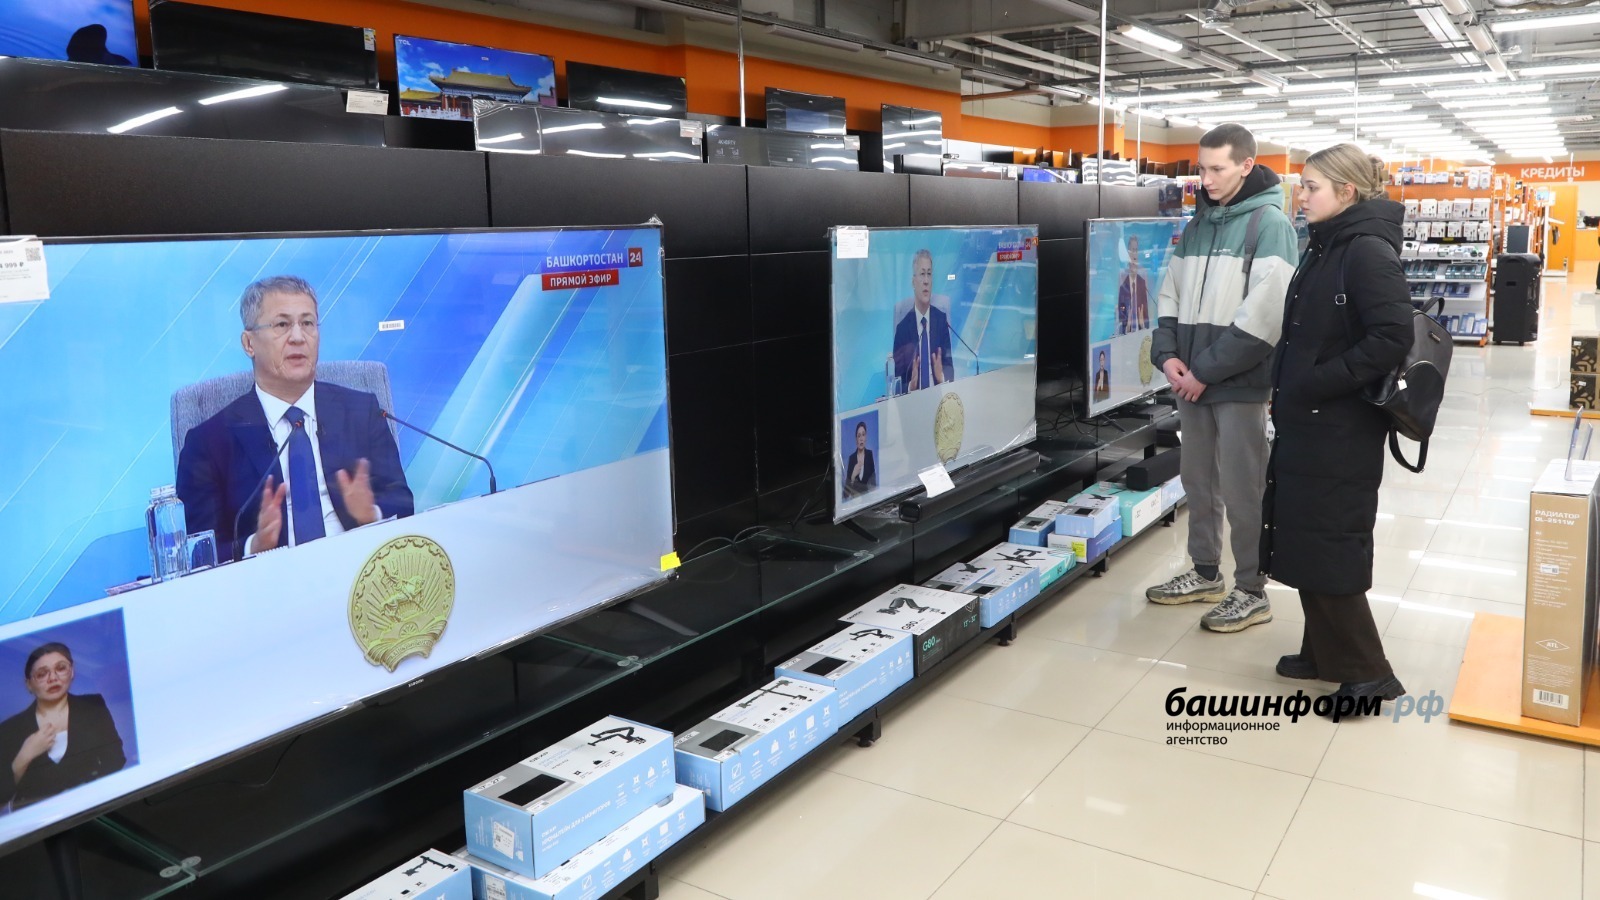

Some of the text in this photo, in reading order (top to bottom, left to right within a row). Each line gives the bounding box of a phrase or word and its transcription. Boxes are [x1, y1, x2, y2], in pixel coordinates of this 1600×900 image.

[1520, 166, 1585, 180] КРЕДИТЫ
[546, 251, 641, 268] БАШКОРТОСТАН 24
[550, 273, 612, 287] ПРЯМОЙ ЭФИР
[1535, 509, 1581, 520] РАДИАТОР
[922, 635, 936, 652] G80
[541, 824, 571, 846] КРОНШТЕЙН
[584, 800, 611, 820] МОНИТОРОВ
